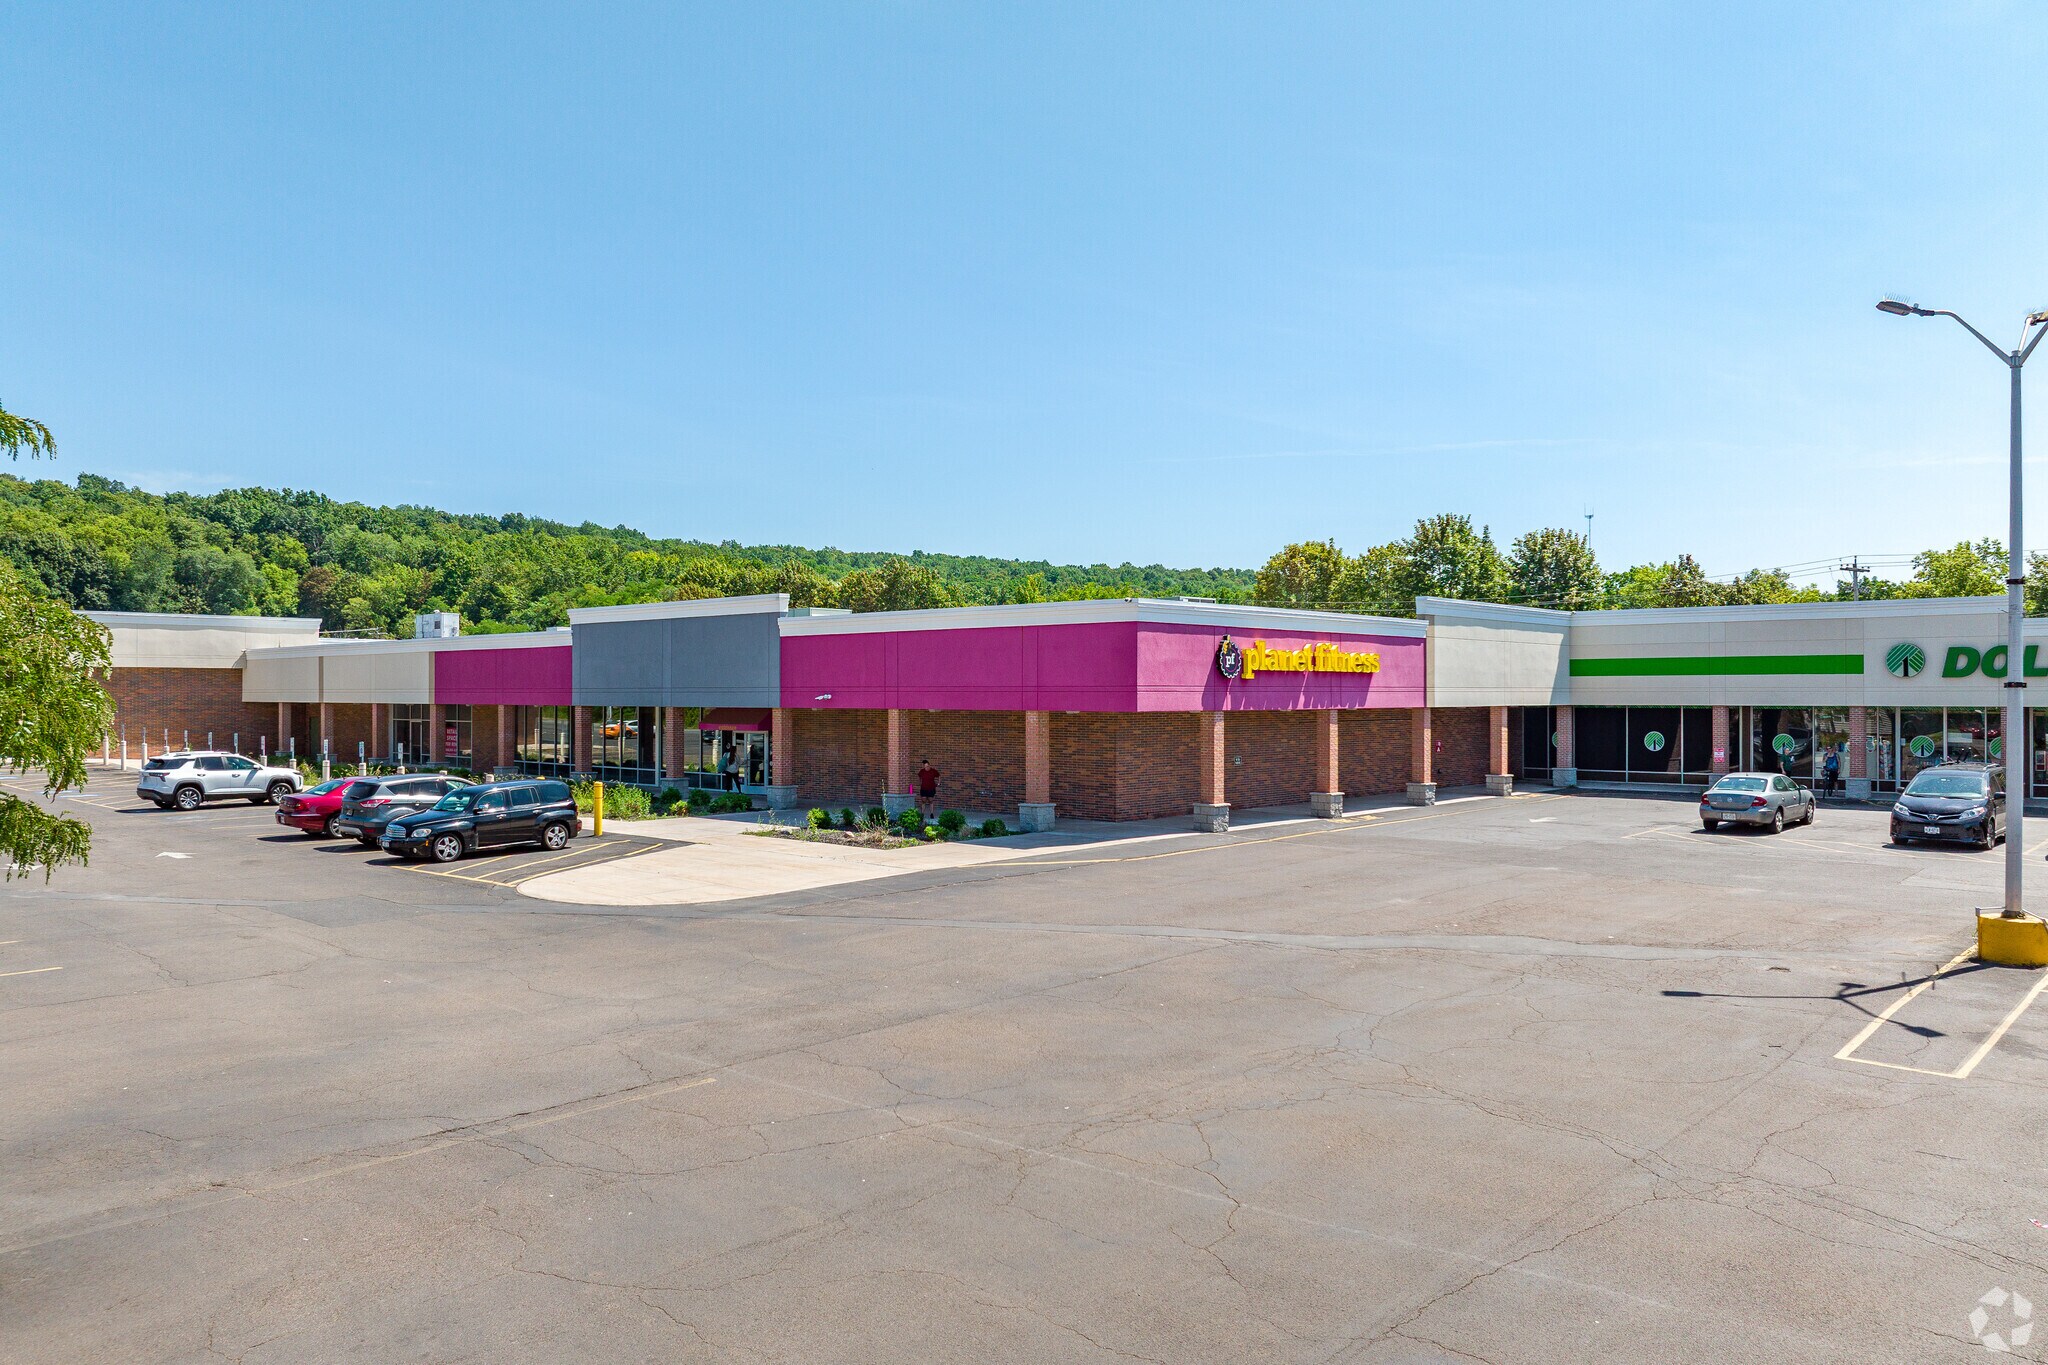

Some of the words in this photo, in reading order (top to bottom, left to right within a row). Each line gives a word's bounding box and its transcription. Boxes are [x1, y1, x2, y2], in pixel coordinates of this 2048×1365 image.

[1225, 653, 1236, 667] pf
[1241, 640, 1314, 679] planet
[1314, 642, 1380, 673] fitness
